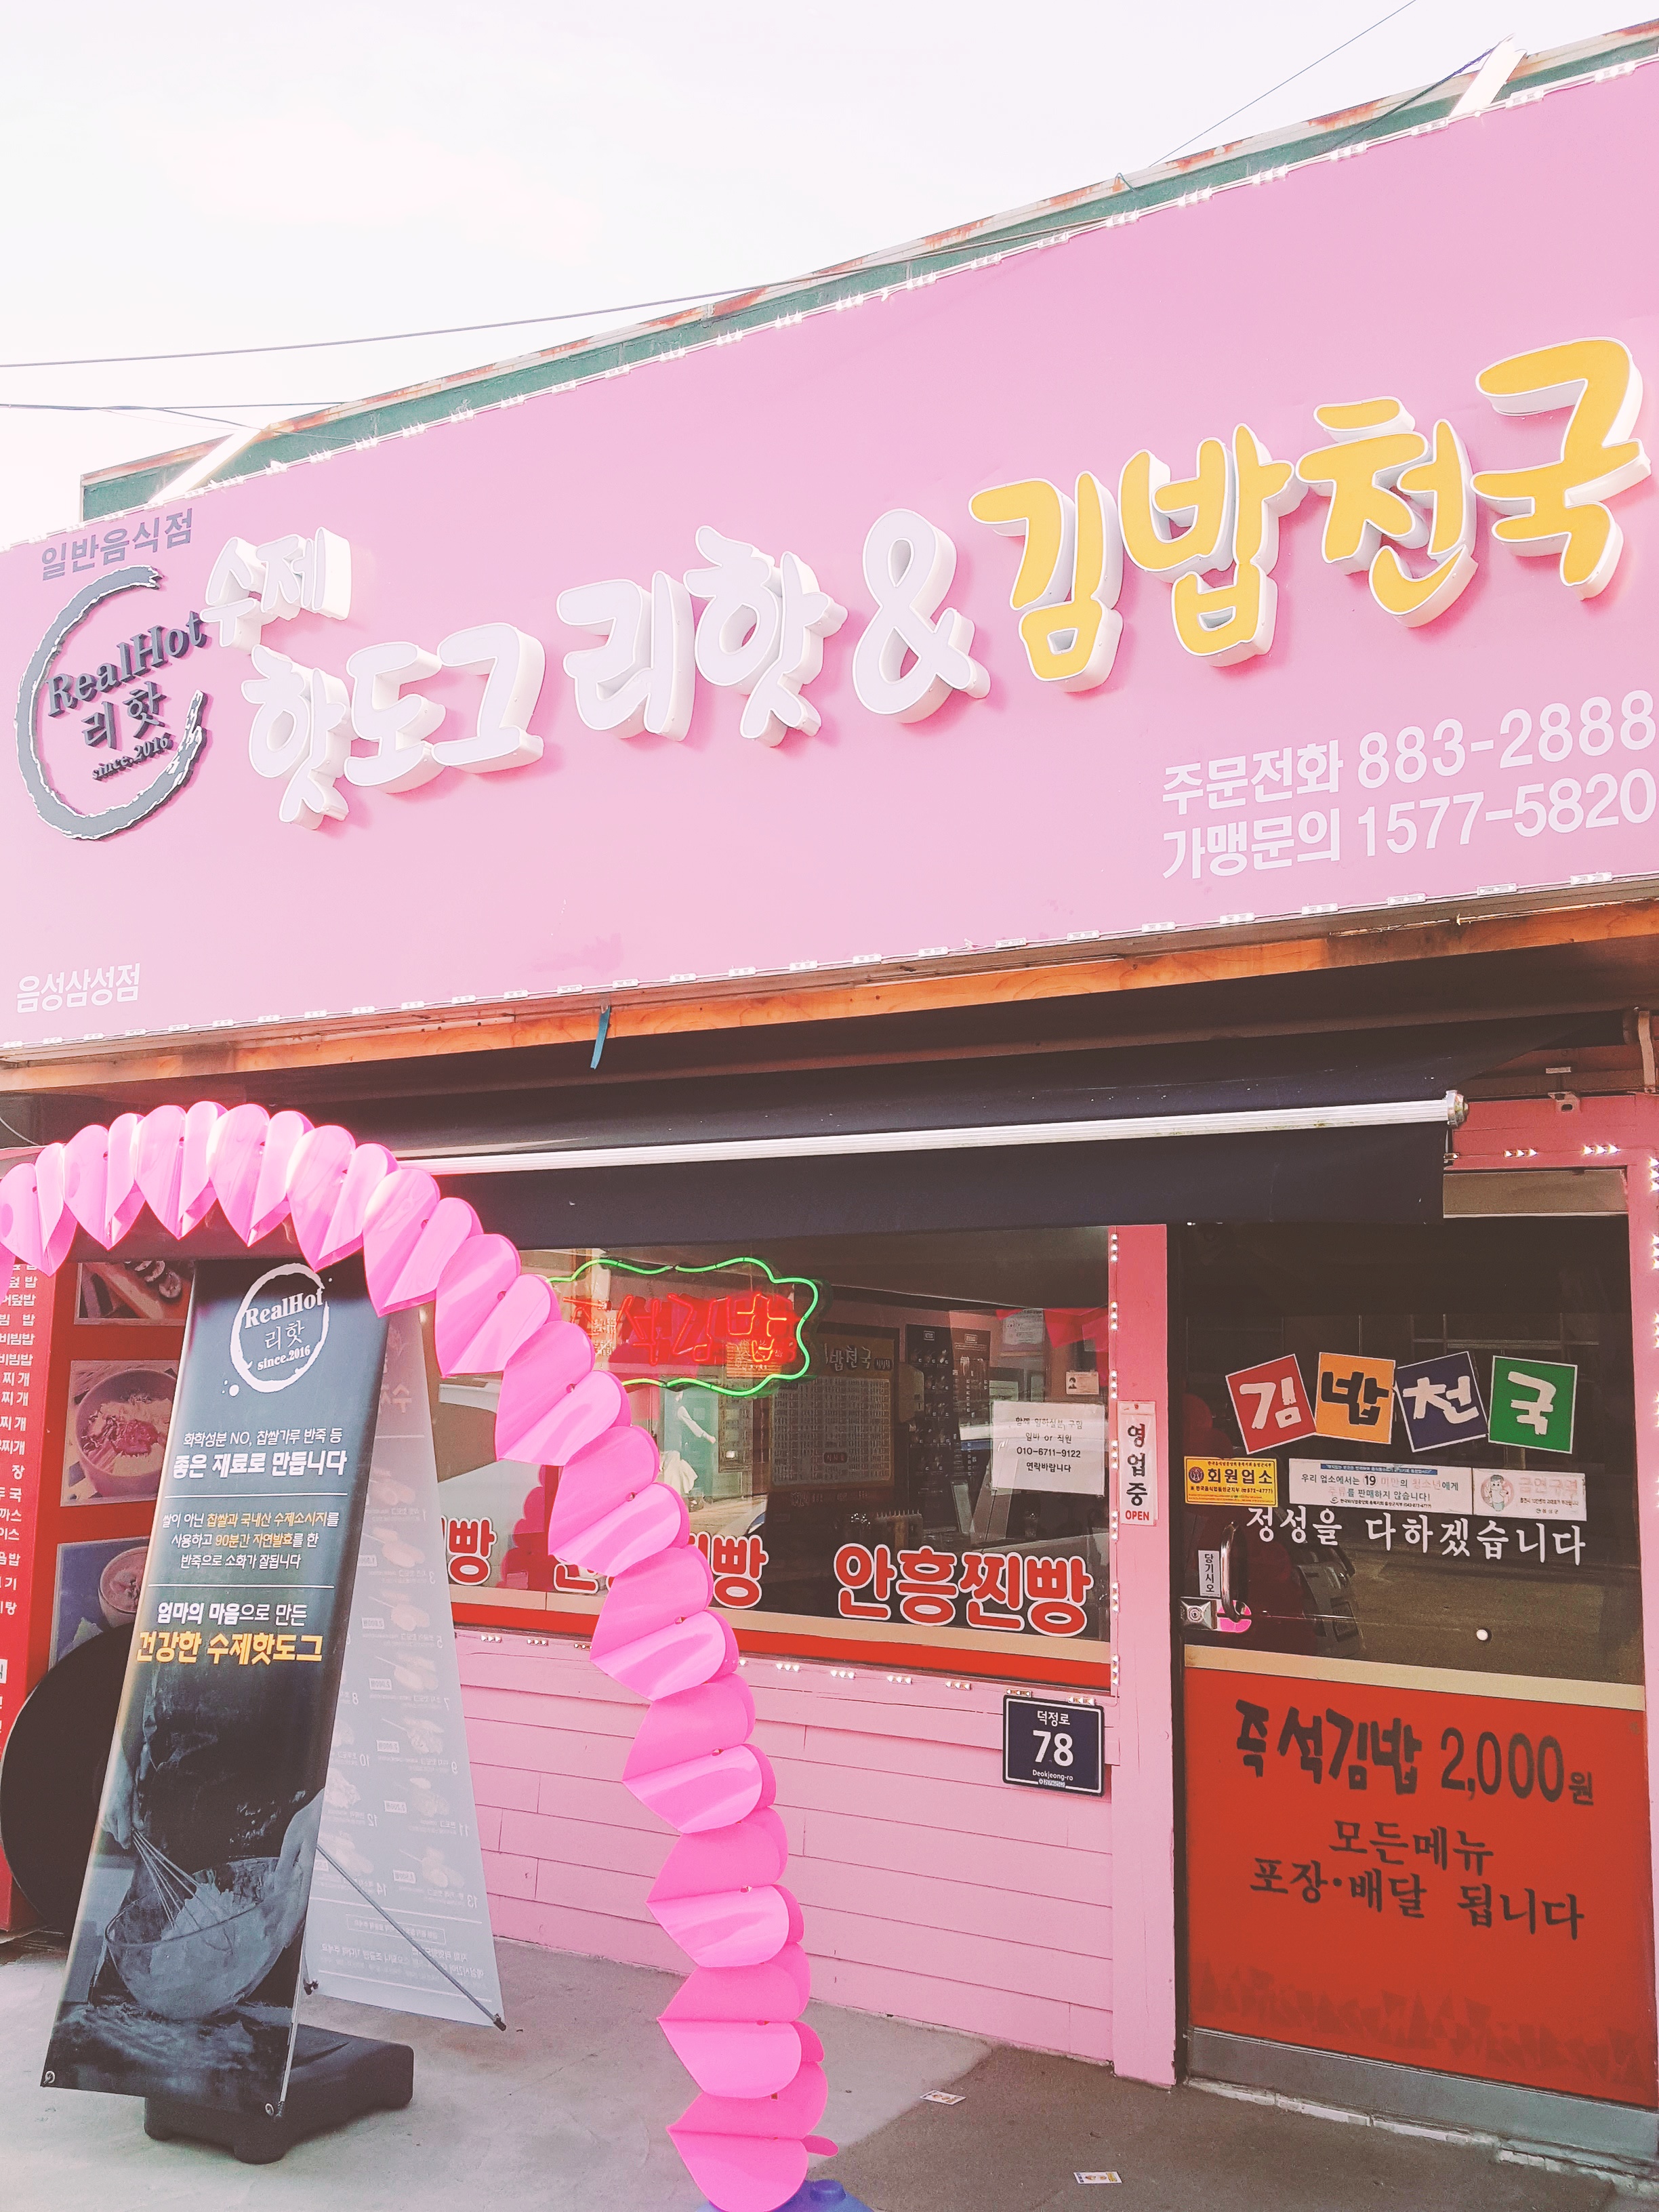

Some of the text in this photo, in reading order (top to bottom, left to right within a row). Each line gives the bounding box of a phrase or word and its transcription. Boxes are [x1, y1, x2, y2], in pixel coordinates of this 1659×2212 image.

[41, 508, 193, 580] 일반음식점
[200, 527, 350, 651] 수제
[241, 336, 1652, 828] 핫도그 리핫 & 김밥천국
[47, 611, 210, 718] RealHot
[1162, 689, 1656, 815] 주문전화 883-2888
[1162, 768, 1657, 880] 가맹문의 1577-5820
[16, 963, 141, 1014] 음성삼성점
[245, 1288, 323, 1329] RealHot
[258, 1345, 310, 1370] since.2016
[0, 1439, 25, 1455] 찌개
[183, 1431, 226, 1448] 화학성분
[256, 1429, 300, 1446] 찹쌀가루
[304, 1427, 327, 1445] 반죽
[329, 1427, 342, 1444] 등
[1017, 1447, 1081, 1458] 010-6711-9122
[1057, 1435, 1072, 1444] 직원
[12, 1465, 25, 1479] 장
[173, 1450, 347, 1479] 좋은 재료로 만듭니다
[1026, 1462, 1071, 1473] 연락바랍니다
[1126, 1423, 1148, 1507] 영업중
[1208, 1468, 1273, 1484] 회원업소
[1301, 1473, 1459, 1491] 우리 업소에서는 19 미만의 청소년에게
[1357, 1490, 1390, 1499] 판매하지
[162, 1511, 340, 1528] 쌀이 아닌 찹쌀과 국내산 수제소시지를
[1125, 1510, 1149, 1521] OPEN
[171, 1532, 319, 1549] 사용하고 90분간 자연발효를 한
[441, 1515, 497, 1586] 빵
[1247, 1506, 1586, 1565] 정성을 다하겠습니다
[180, 1553, 302, 1570] 반죽으로 소화가 잘됩니다
[1204, 1553, 1214, 1593] 당기시오
[834, 1543, 1094, 1637] 안흥찐빵
[157, 1601, 308, 1626] 엄마의 마음으로 만든
[136, 1631, 202, 1663] 건강한
[207, 1632, 323, 1666] 수제핫도그
[1037, 1710, 1071, 1727] 덕정로
[1033, 1729, 1073, 1767] 78
[1235, 1699, 1422, 1795] 즉석김밥
[1032, 1769, 1073, 1781] Deokjeong-ro
[1328, 1820, 1494, 1876] 모든메뉴
[1250, 1858, 1584, 1941] 포장·배달 됩니다
